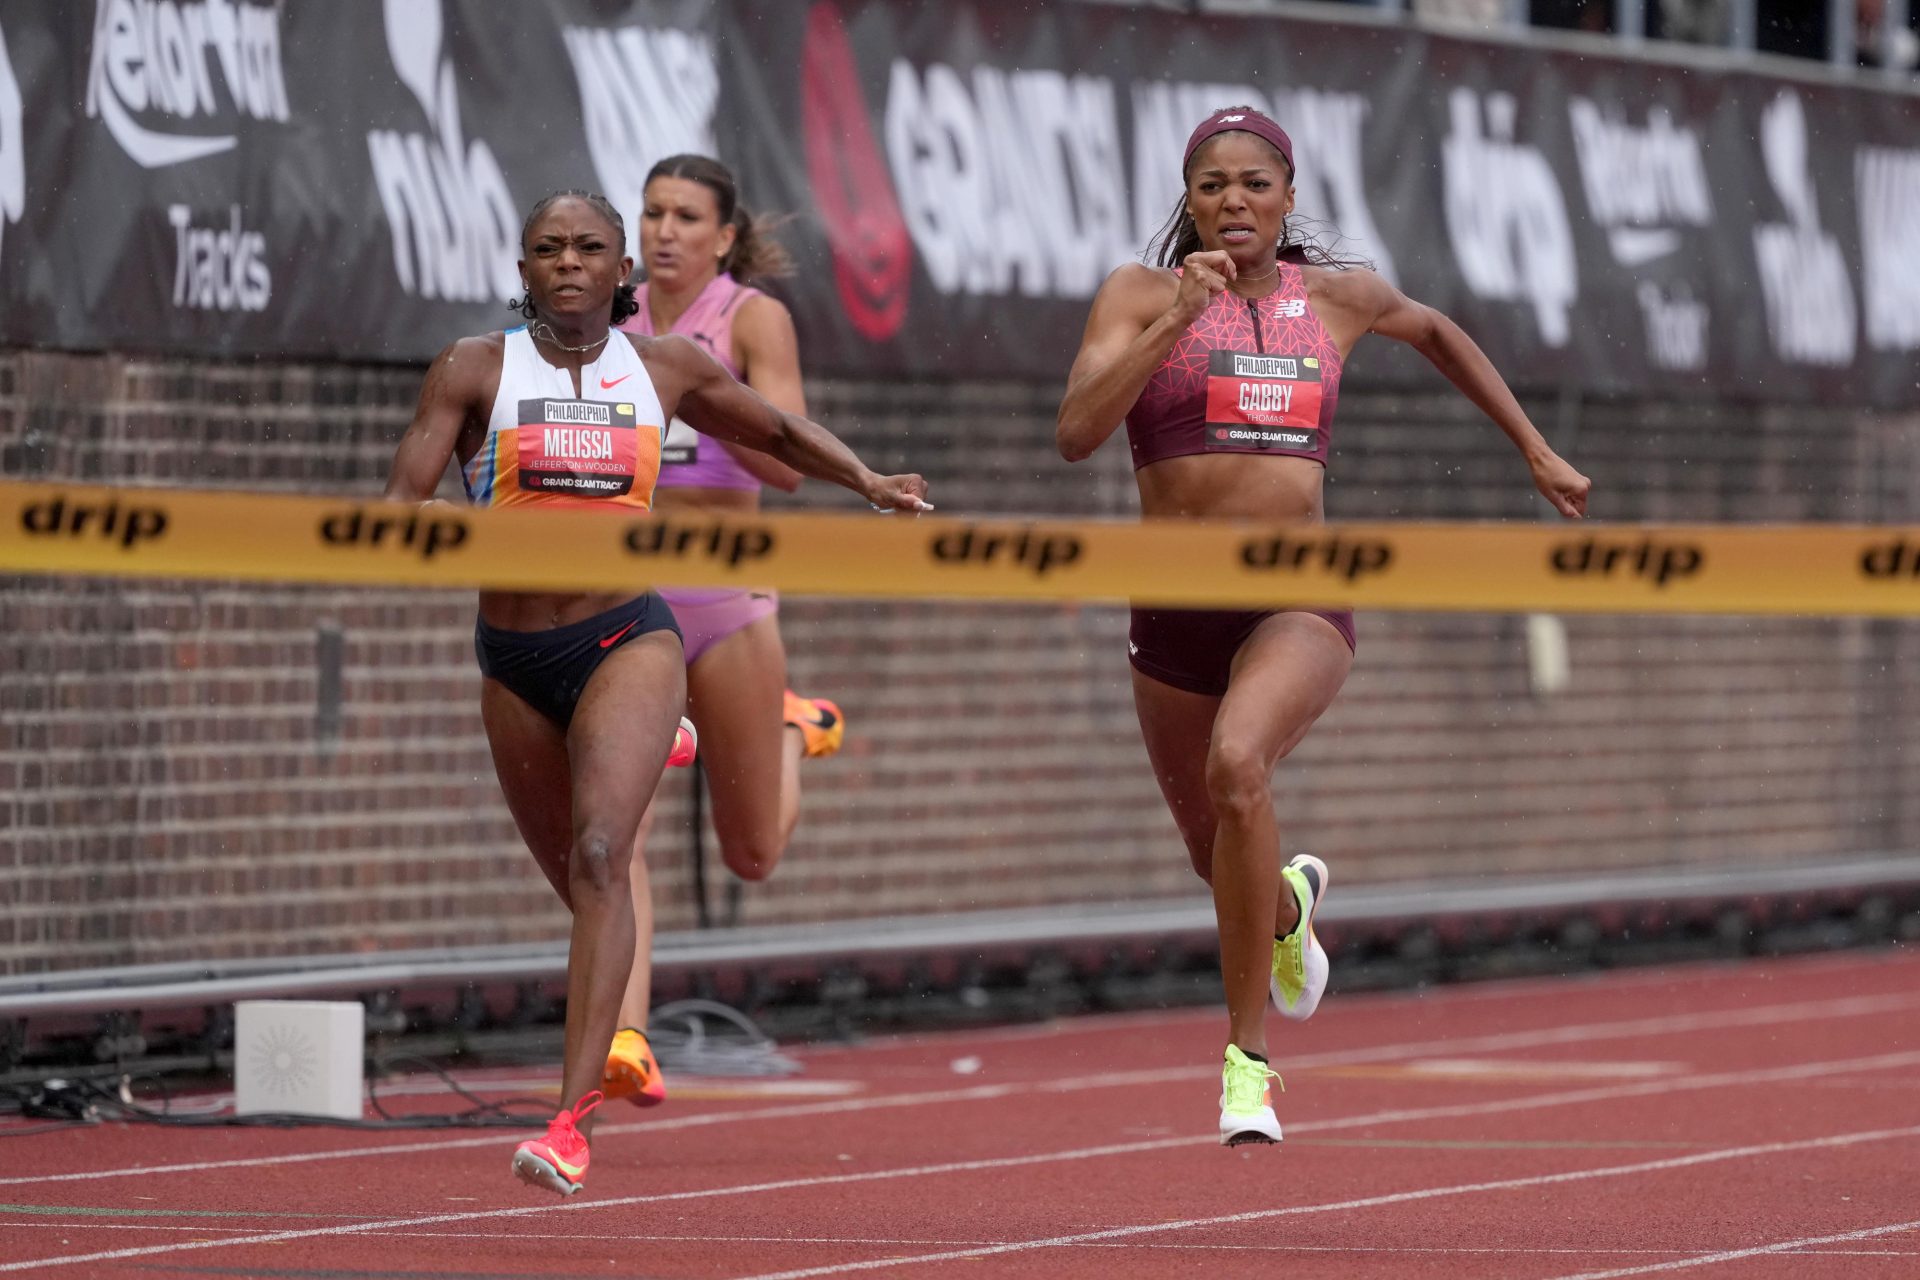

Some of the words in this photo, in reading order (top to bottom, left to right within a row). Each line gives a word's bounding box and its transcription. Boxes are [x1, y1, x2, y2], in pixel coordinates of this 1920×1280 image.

[168, 203, 272, 312] Tracks
[1273, 299, 1306, 319] NB
[1236, 357, 1296, 377] PHILADELPHIA
[546, 403, 609, 422] PHILADELPHIA
[1239, 382, 1293, 412] GABBY
[1246, 413, 1285, 424] THOMAS
[544, 428, 612, 460] MELISSA
[1229, 430, 1261, 440] GRAND
[1261, 431, 1281, 442] SLAM
[1281, 433, 1310, 444] TRACK
[528, 459, 627, 473] JEFFERSON-WOODEN
[542, 477, 574, 487] GRAND
[574, 479, 596, 489] SLAM
[595, 481, 624, 491] TRACK
[18, 495, 169, 549] drip
[318, 503, 470, 559] drip
[622, 510, 777, 568] drip
[929, 519, 1085, 575] drip
[1238, 525, 1395, 581] drip
[1549, 530, 1705, 587] drip
